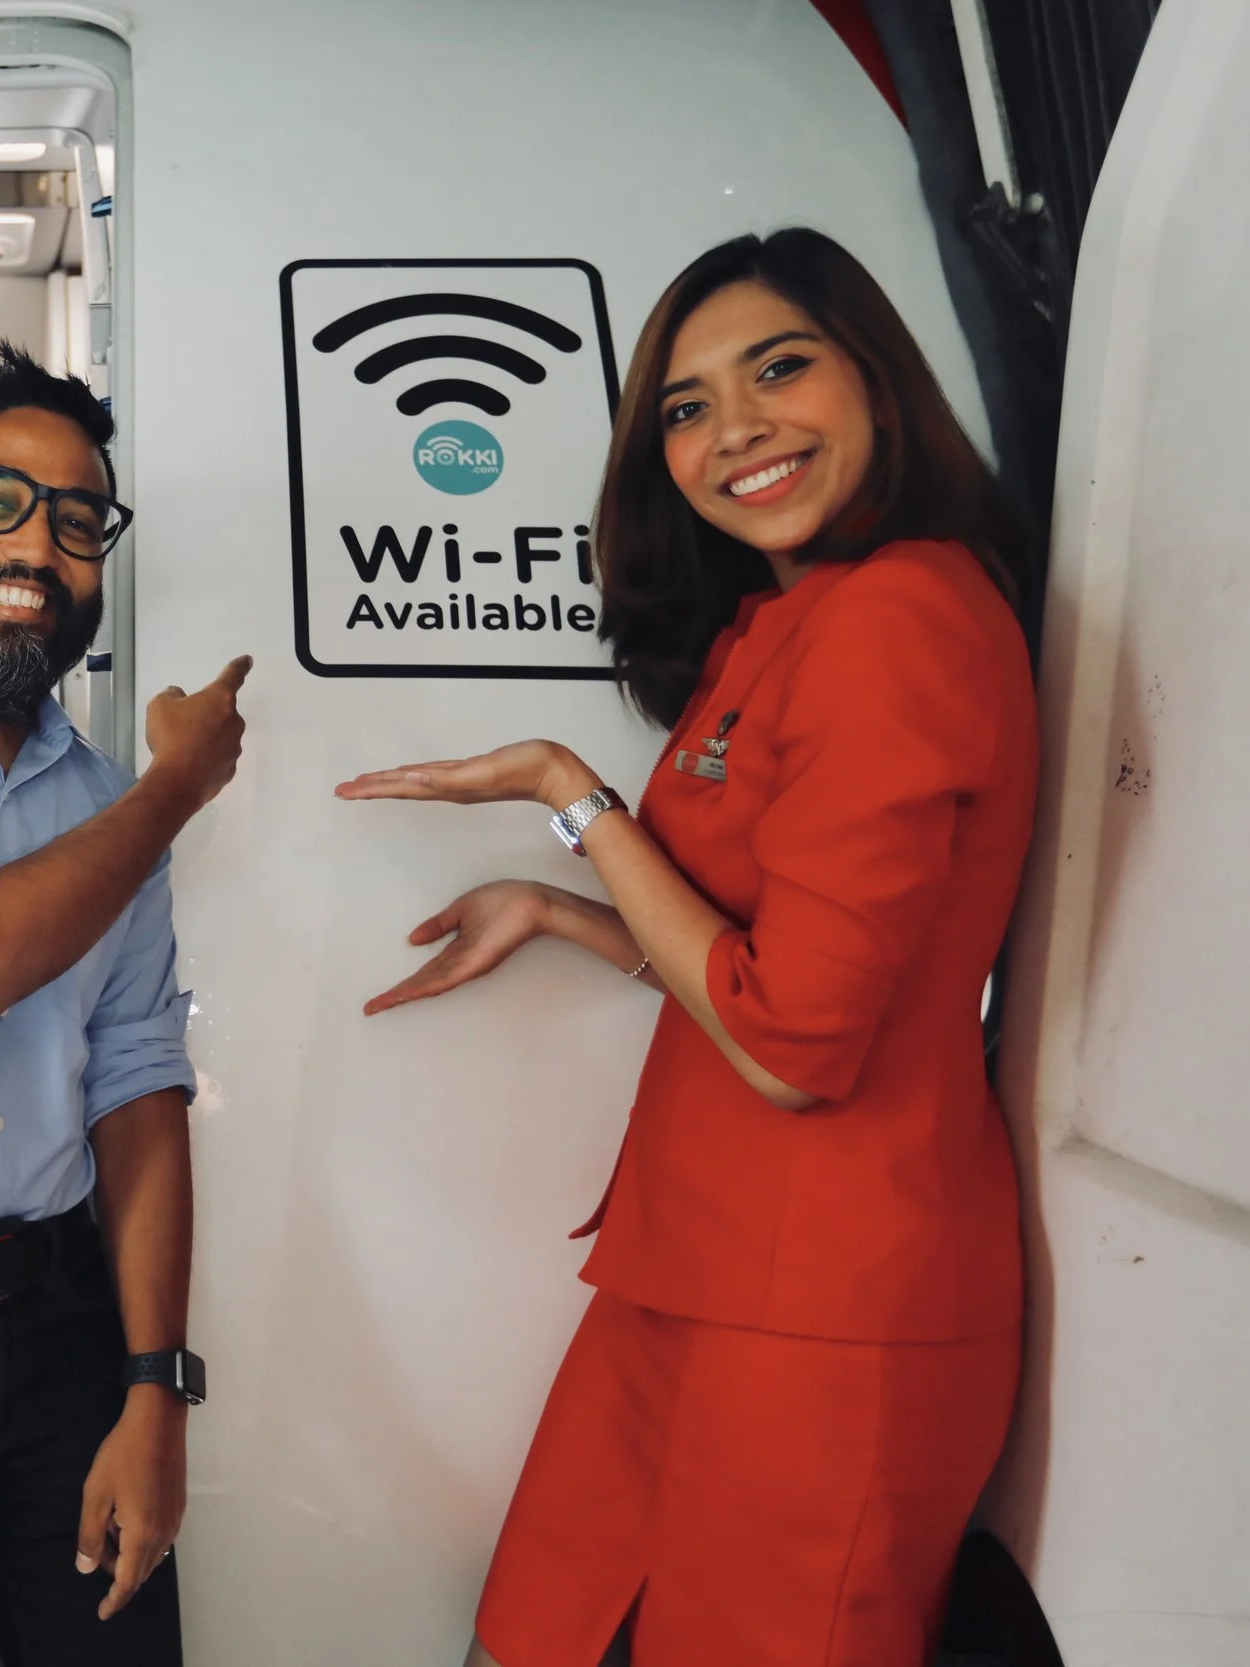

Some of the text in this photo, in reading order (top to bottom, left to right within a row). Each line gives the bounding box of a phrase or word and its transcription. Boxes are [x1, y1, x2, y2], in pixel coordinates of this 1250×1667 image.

[418, 447, 498, 466] ROKKI
[471, 466, 499, 474] .com
[340, 523, 593, 585] Wi-Fi
[346, 593, 596, 632] Available
